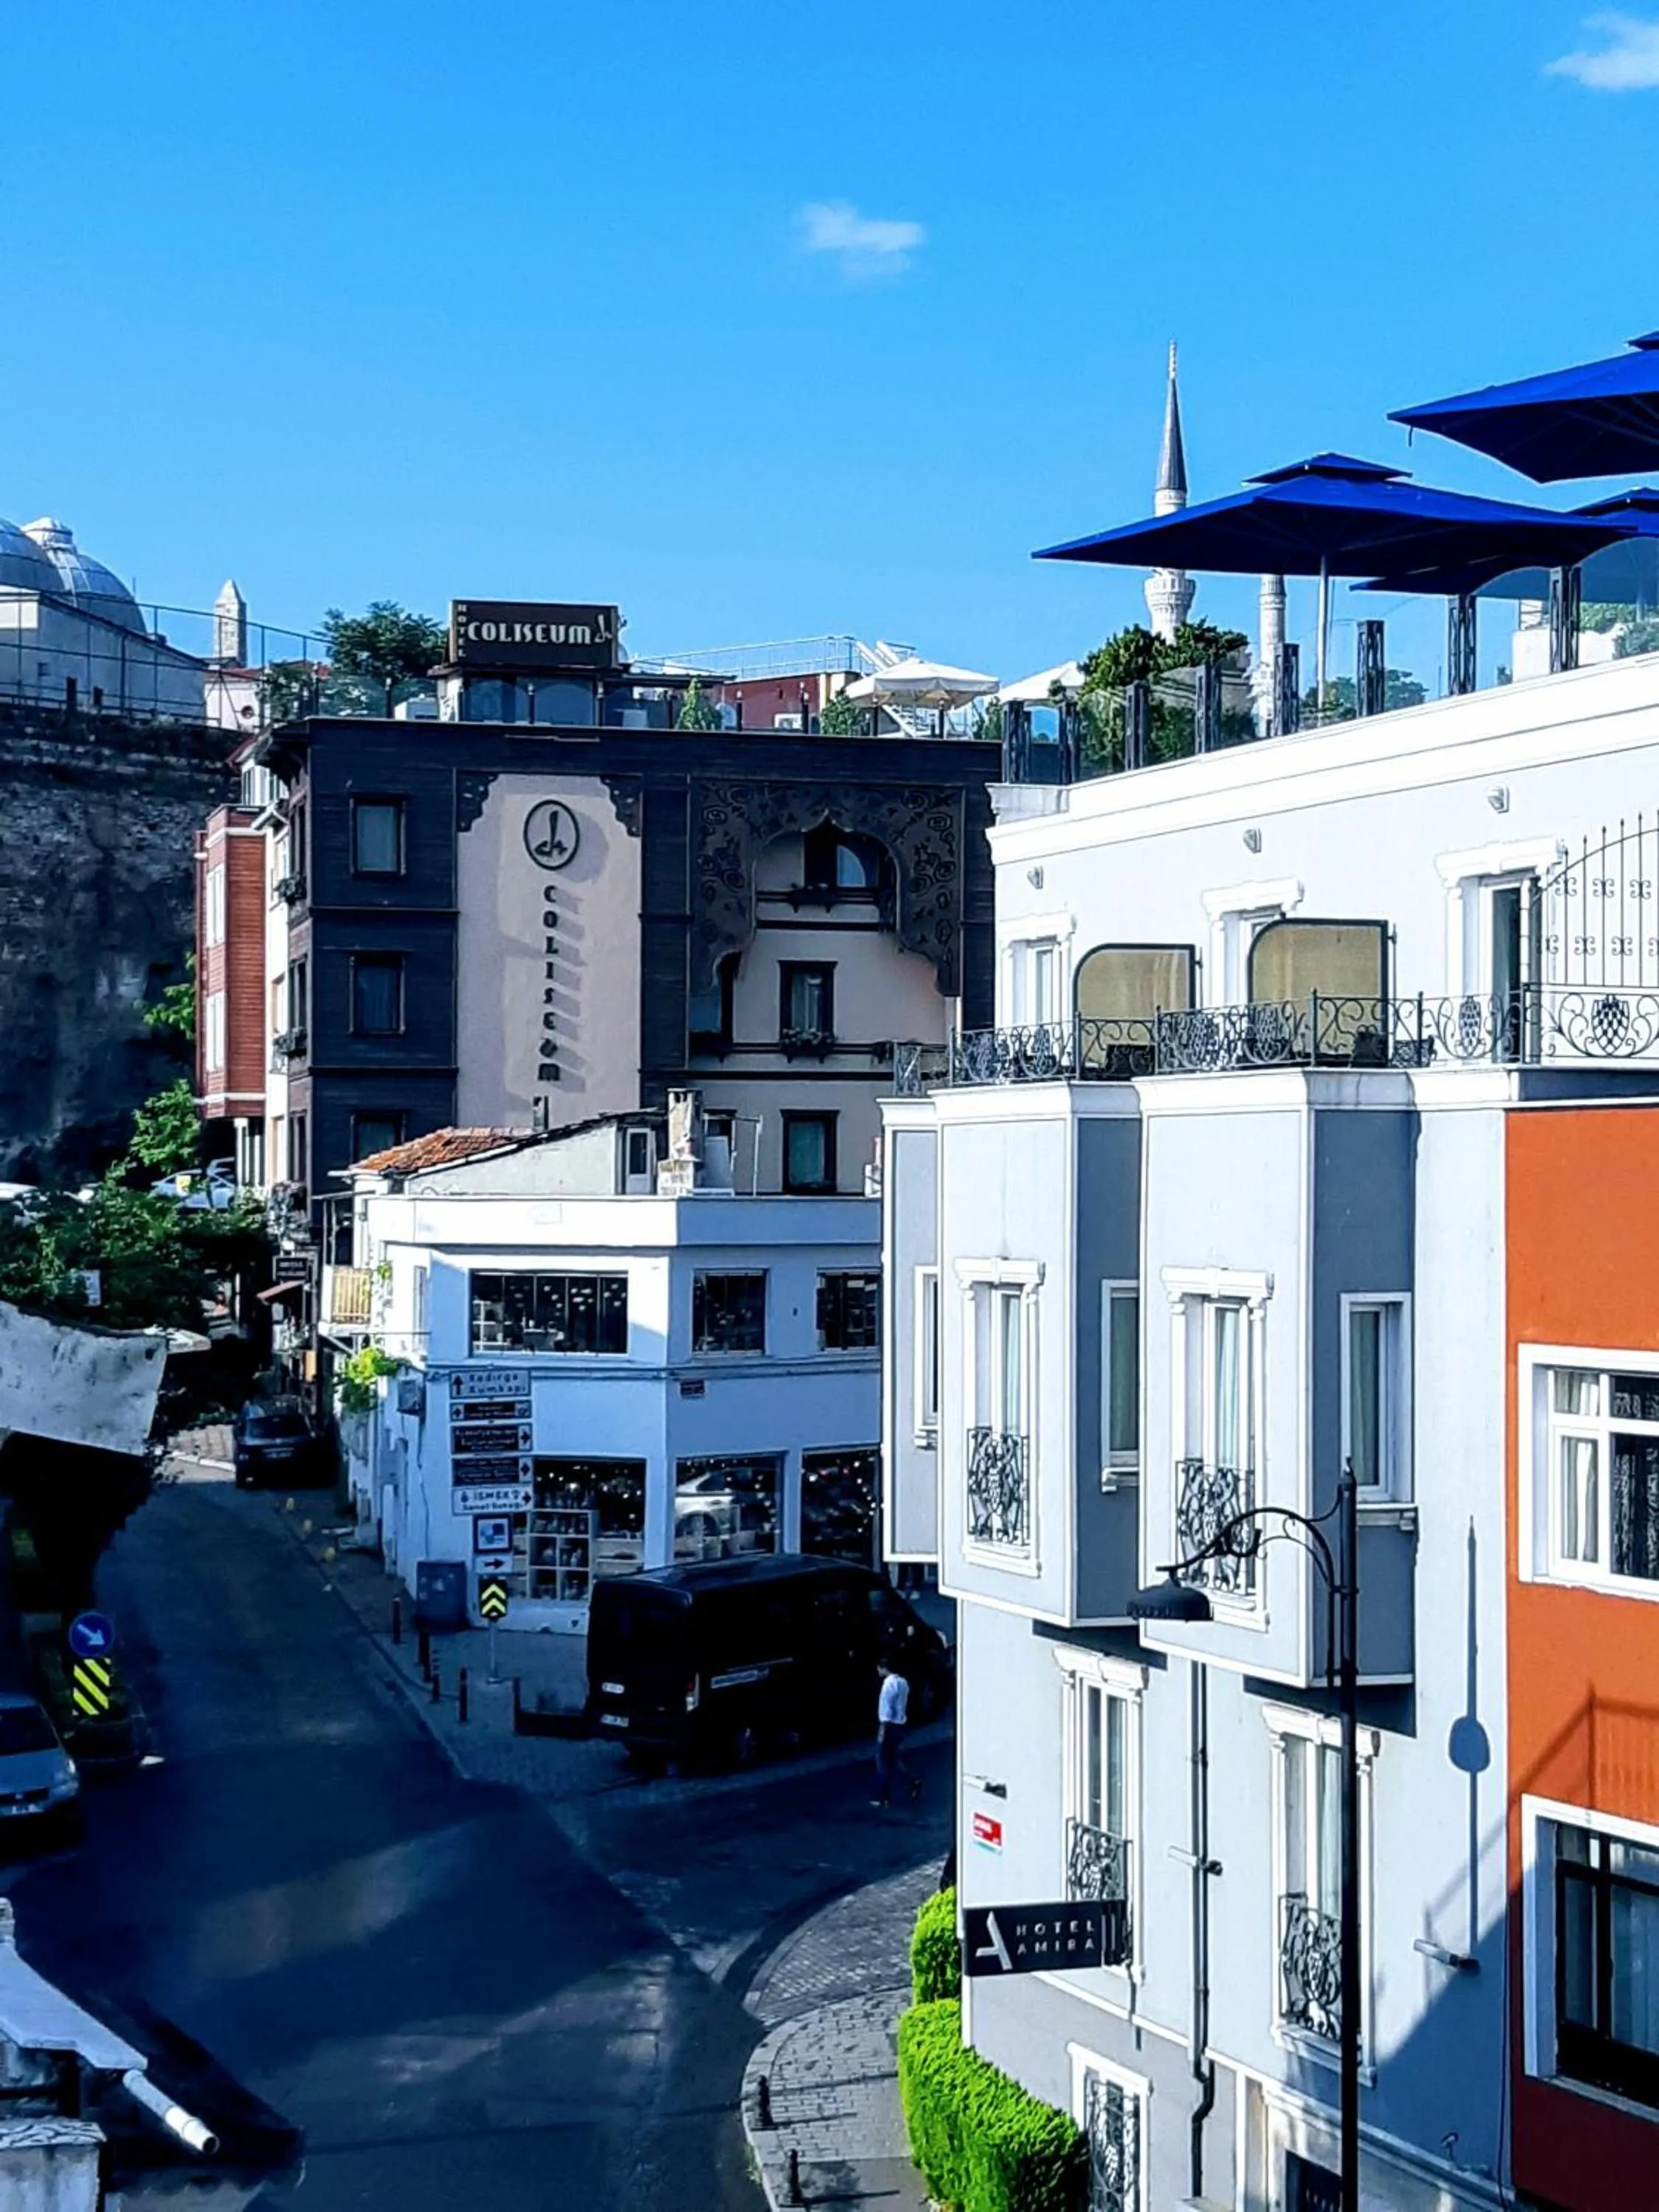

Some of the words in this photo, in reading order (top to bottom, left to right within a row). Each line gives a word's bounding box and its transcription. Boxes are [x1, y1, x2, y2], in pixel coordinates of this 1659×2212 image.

[457, 603, 467, 658] HOTEL
[467, 621, 592, 645] COLISEUM
[538, 885, 561, 1082] COLISEUM
[1016, 1919, 1095, 1936] HOTEL
[1017, 1939, 1096, 1955] AMIRA
